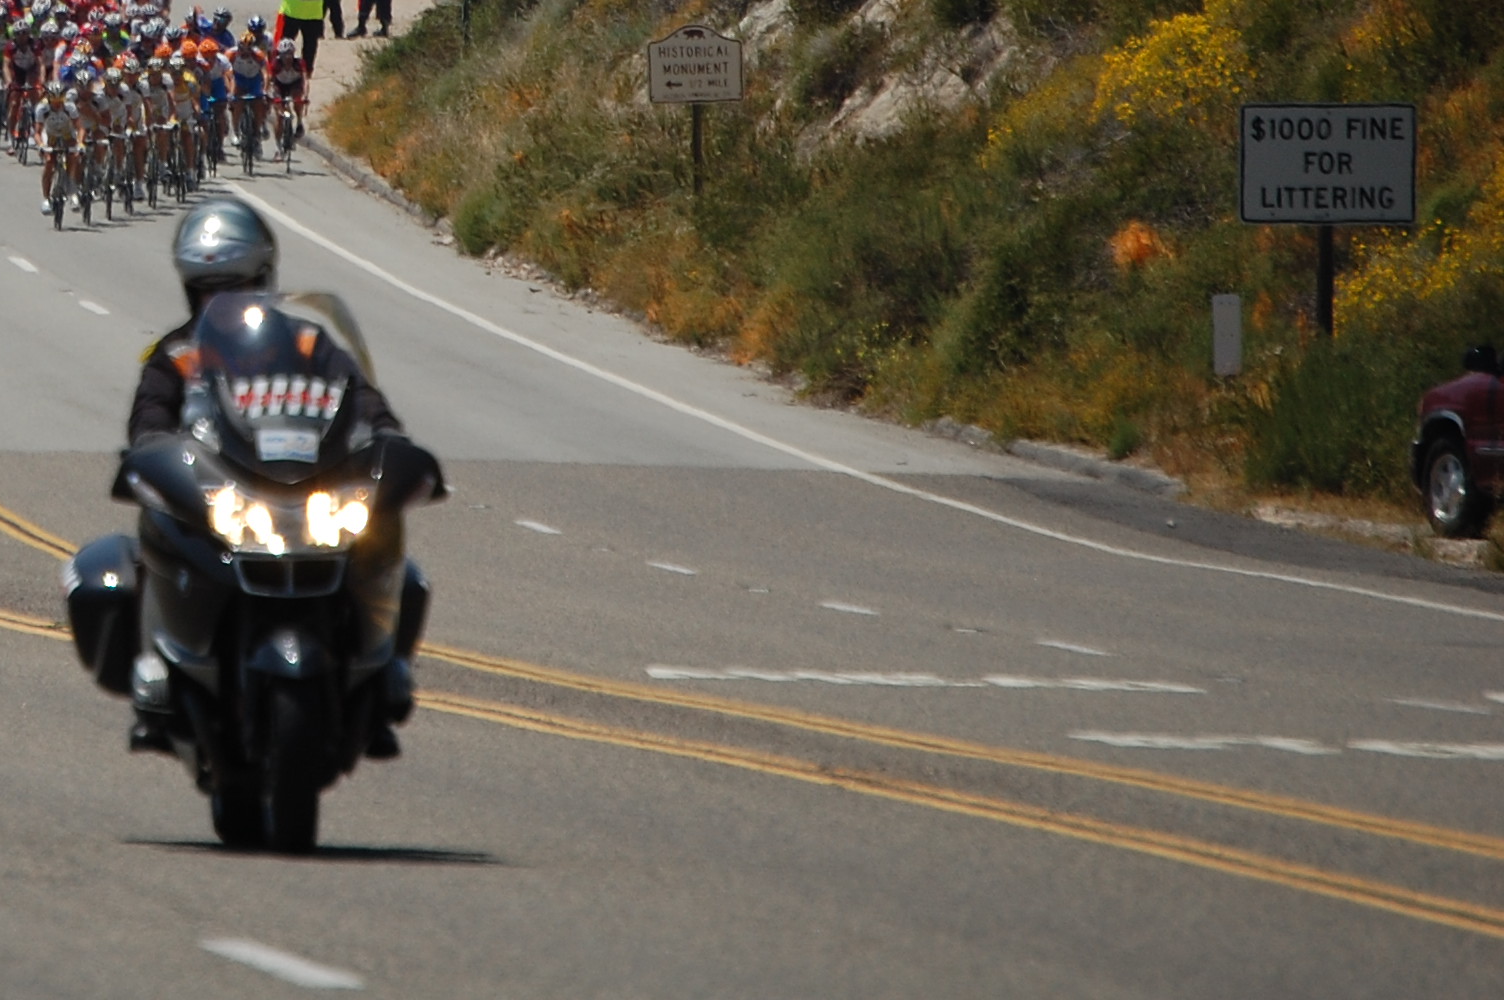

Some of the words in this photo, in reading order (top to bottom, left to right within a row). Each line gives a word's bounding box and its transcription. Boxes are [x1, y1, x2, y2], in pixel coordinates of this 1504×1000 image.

[658, 45, 729, 59] HISTORICAL
[663, 61, 729, 76] MONUMENT
[1251, 115, 1332, 142] $1000
[1346, 117, 1405, 141] FINE
[1304, 152, 1354, 175] FOR
[1260, 186, 1396, 210] LITTERING
